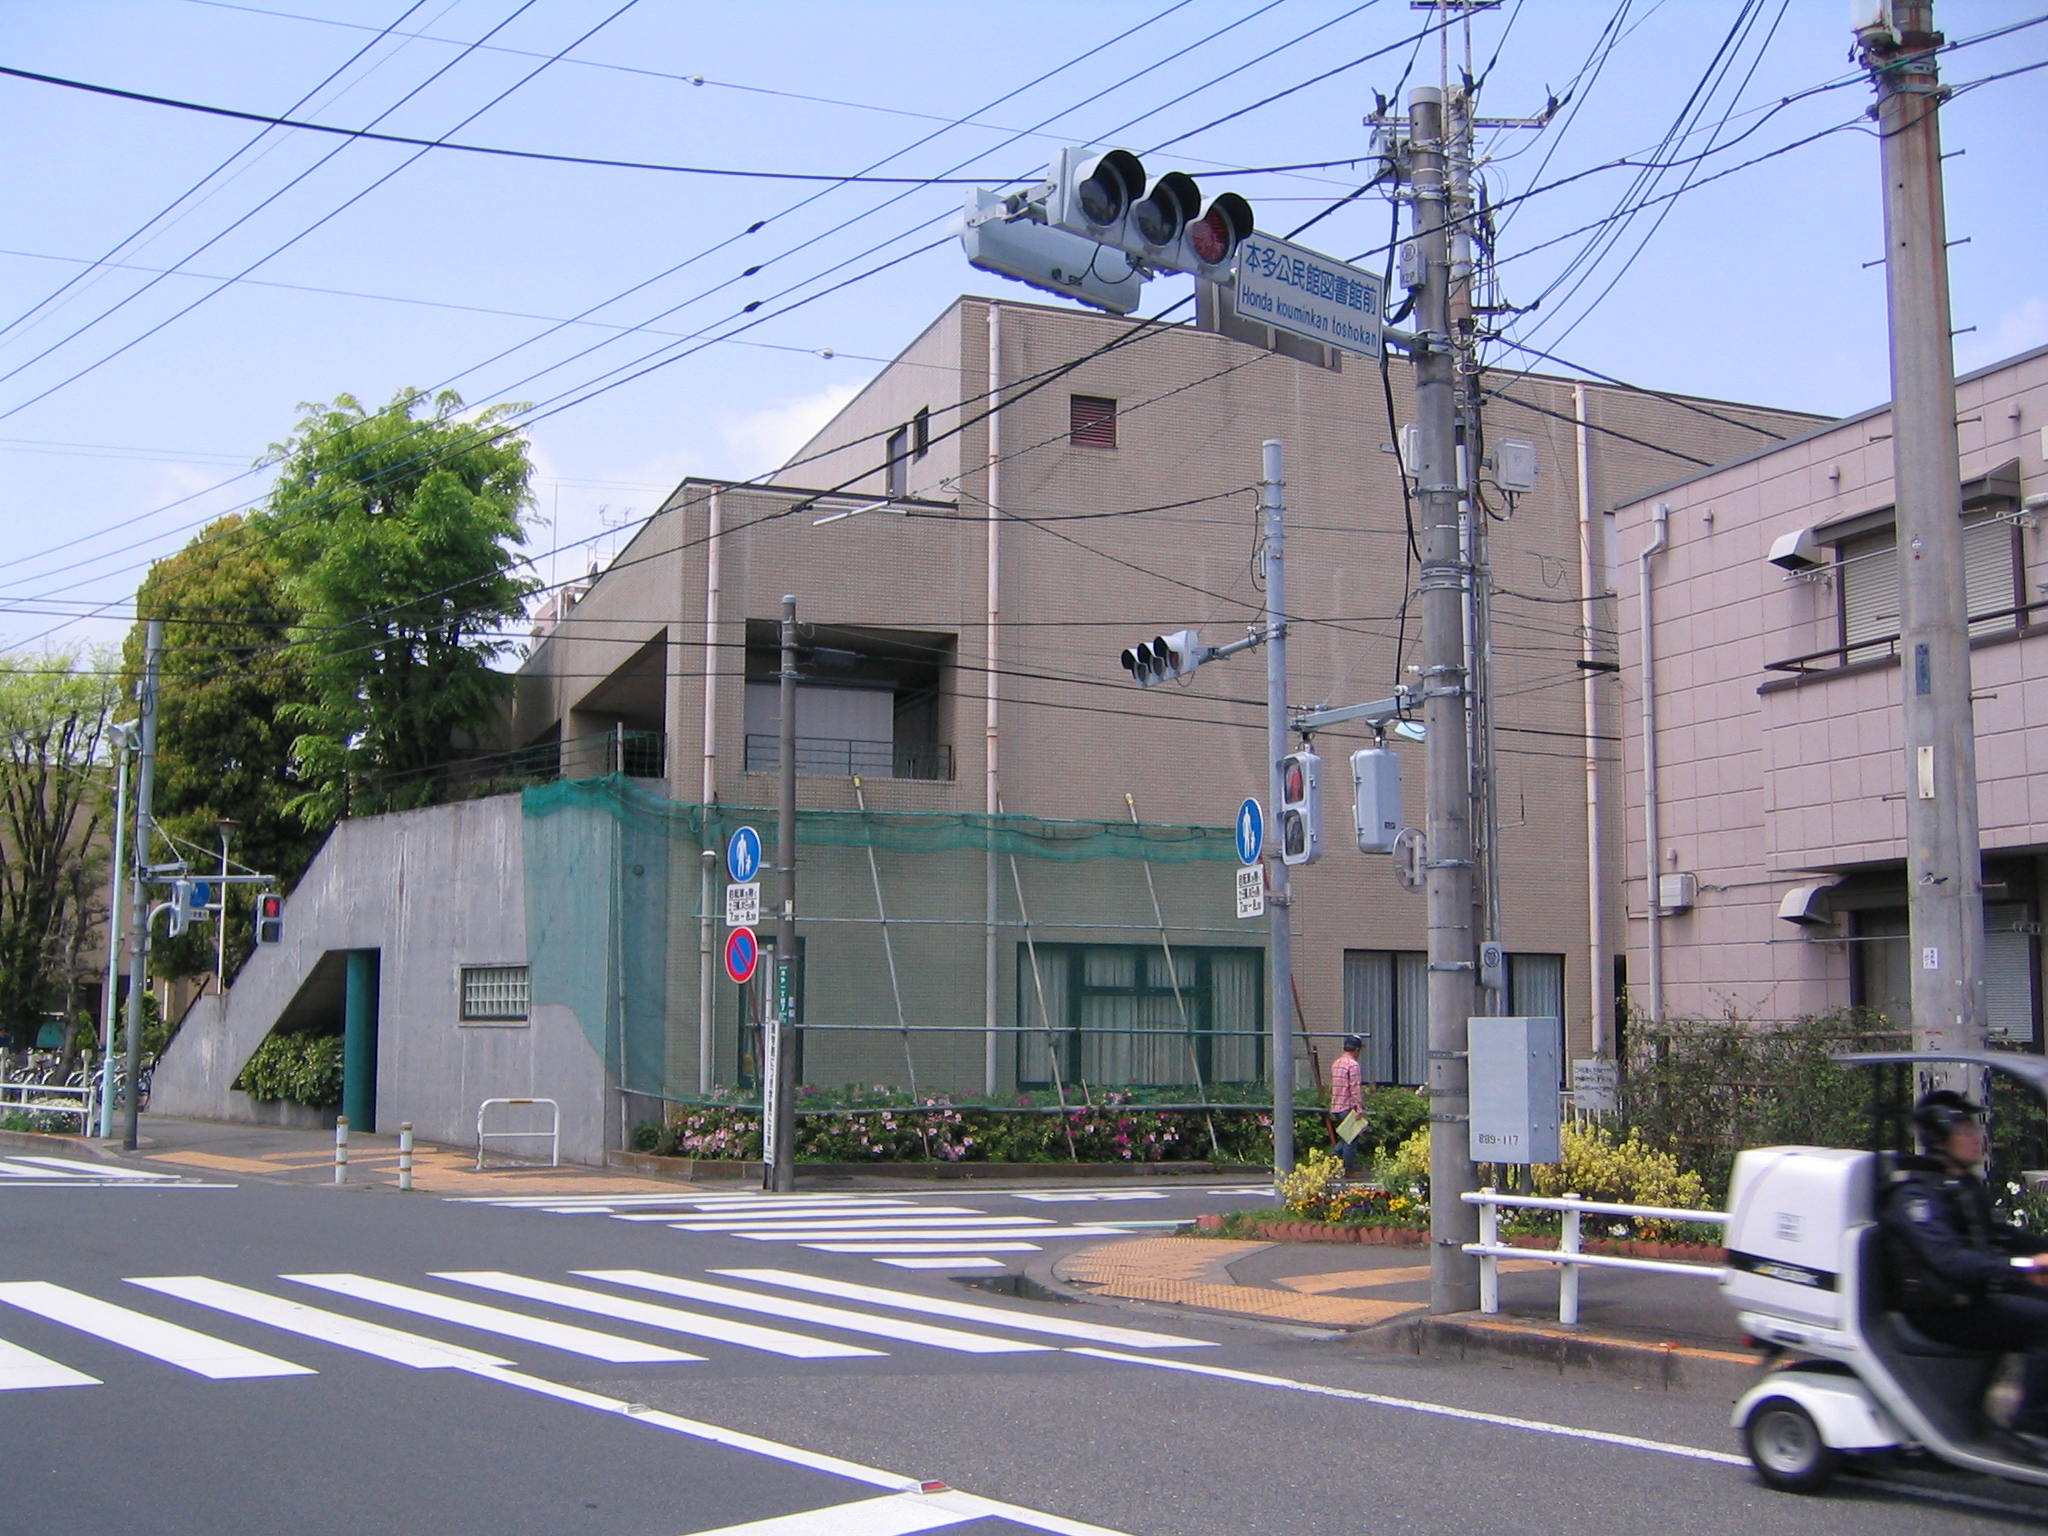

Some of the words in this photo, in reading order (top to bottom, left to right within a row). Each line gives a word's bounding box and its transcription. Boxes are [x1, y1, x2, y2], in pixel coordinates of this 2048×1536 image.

[1245, 242, 1377, 315] 本多公民館図書館前
[1241, 284, 1273, 312] Honda
[1276, 296, 1328, 332] kouminkan
[1332, 315, 1377, 346] toshokan
